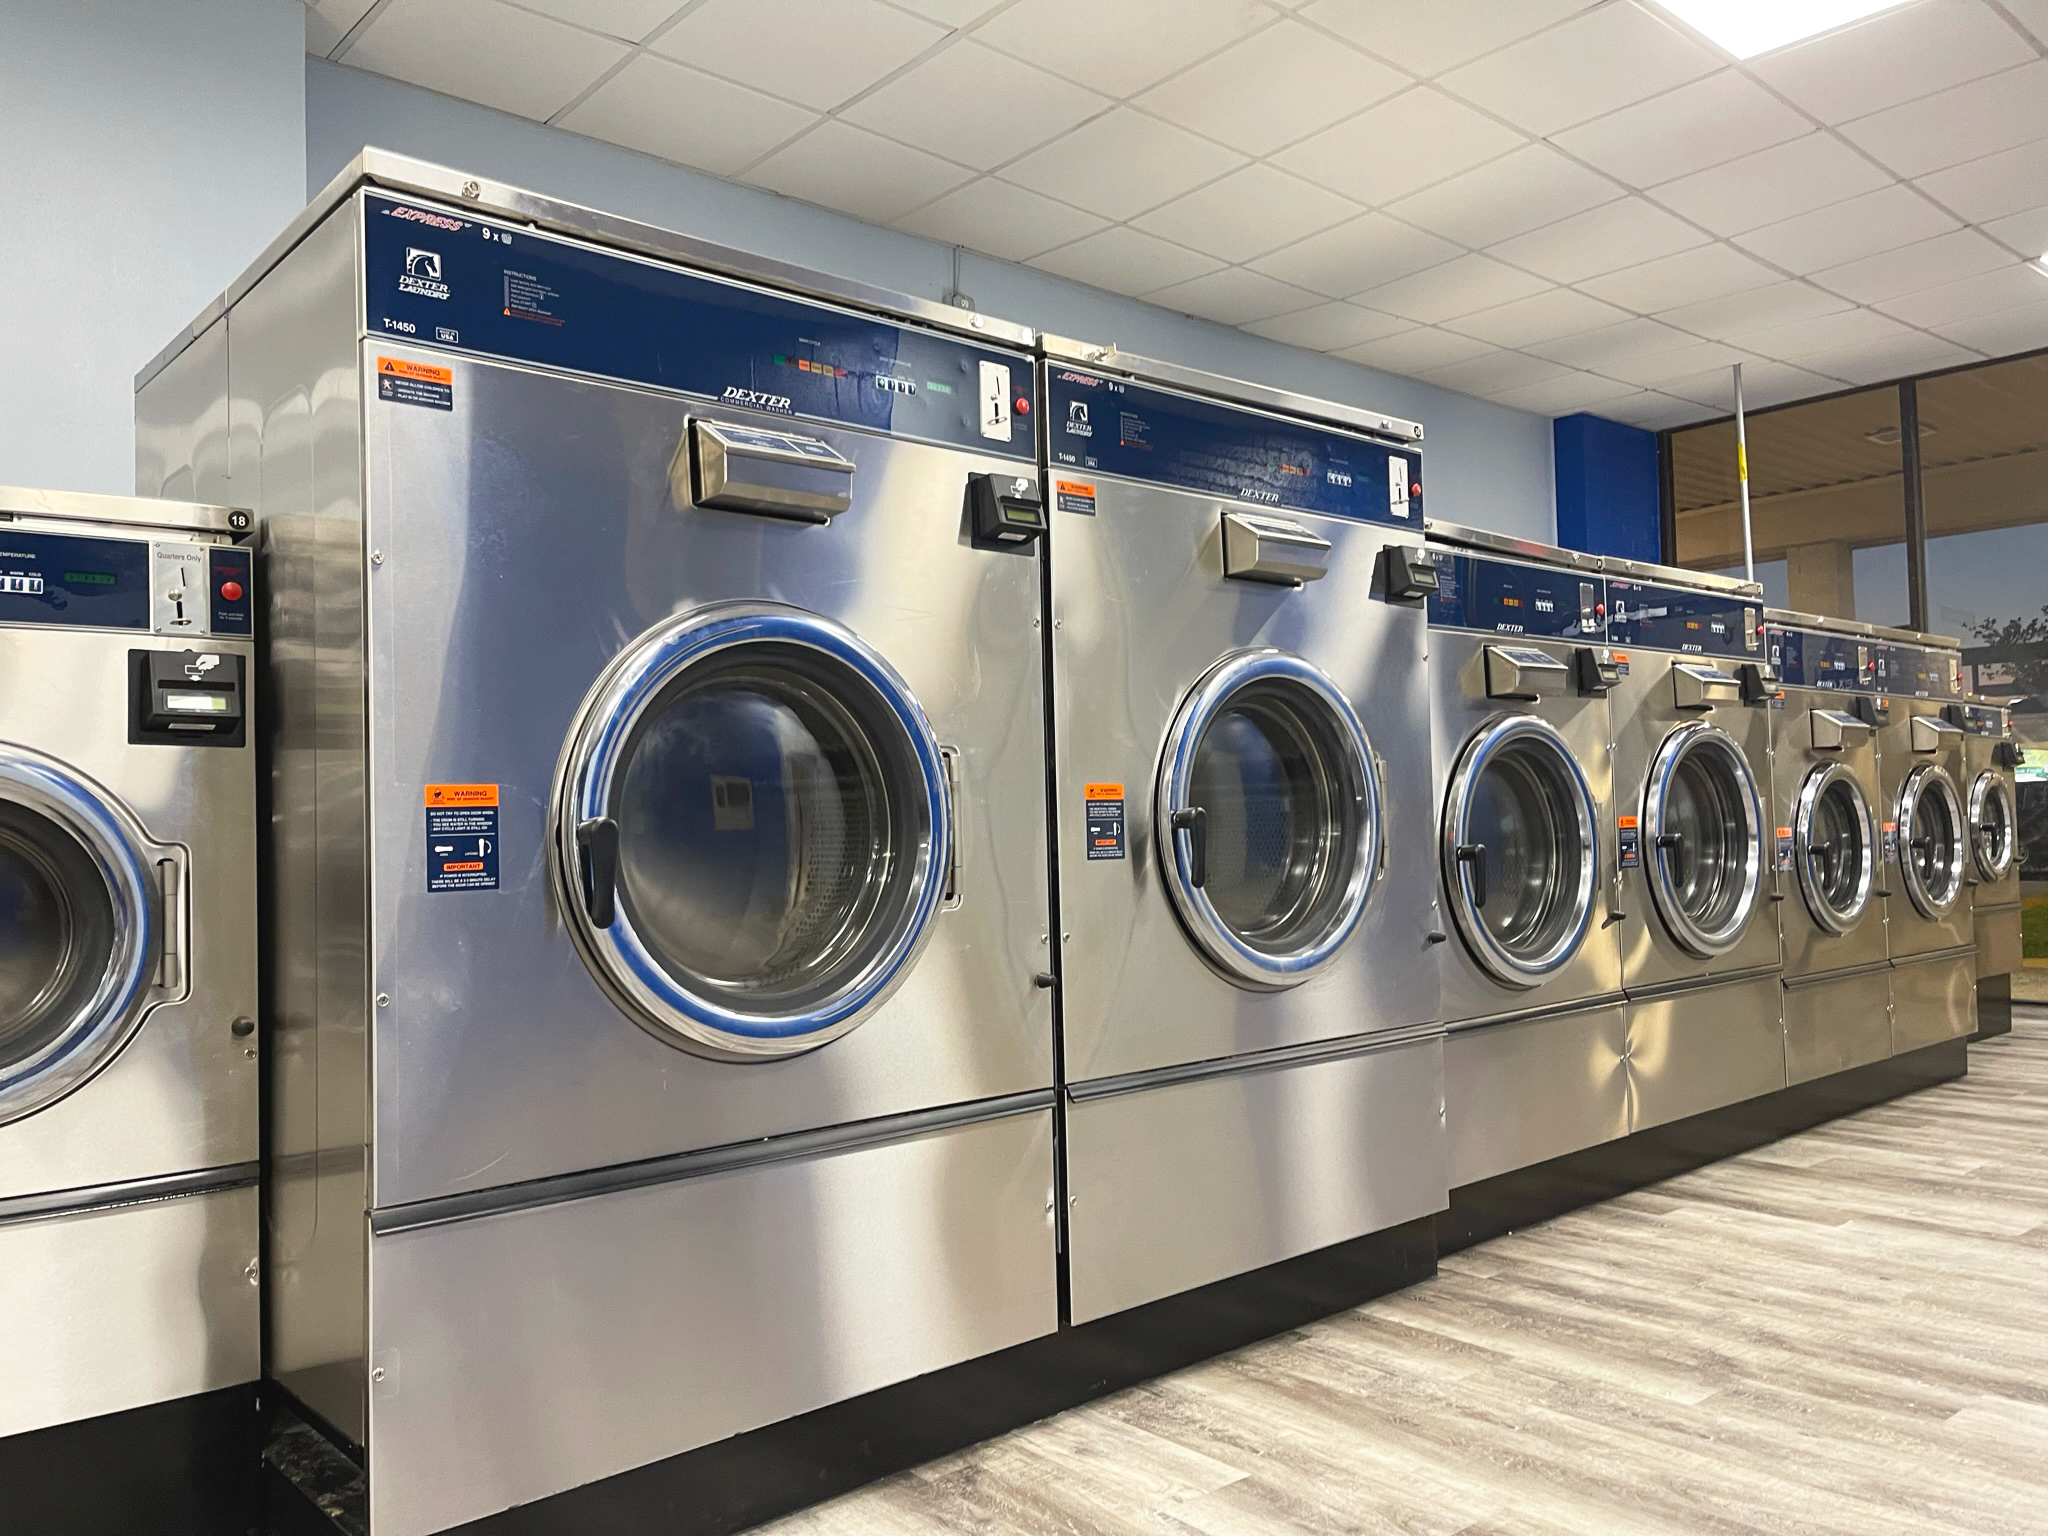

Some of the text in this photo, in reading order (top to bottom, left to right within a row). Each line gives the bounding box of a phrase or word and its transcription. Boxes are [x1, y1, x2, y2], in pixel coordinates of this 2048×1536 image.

[391, 206, 463, 231] EXPRESS
[482, 228, 499, 242] 9 x
[504, 269, 537, 281] INSTRUCTIONS
[399, 275, 449, 293] DEXTER
[398, 284, 450, 300] LAUNDRY
[383, 318, 416, 334] T-1450
[407, 364, 440, 376] WARNING
[1062, 372, 1099, 387] EXPRESS
[723, 386, 791, 409] DEXTER
[720, 396, 793, 415] COMMERCIAL WASHER
[1066, 421, 1092, 432] DEXTER
[1058, 452, 1076, 463] T-1450
[1241, 488, 1279, 502] DEXTER
[231, 515, 246, 526] 18
[0, 551, 36, 559] EMPERATURE
[157, 551, 201, 562] Quarters Only
[1497, 623, 1523, 633] DEXTER
[1682, 643, 1702, 652] DEXTER
